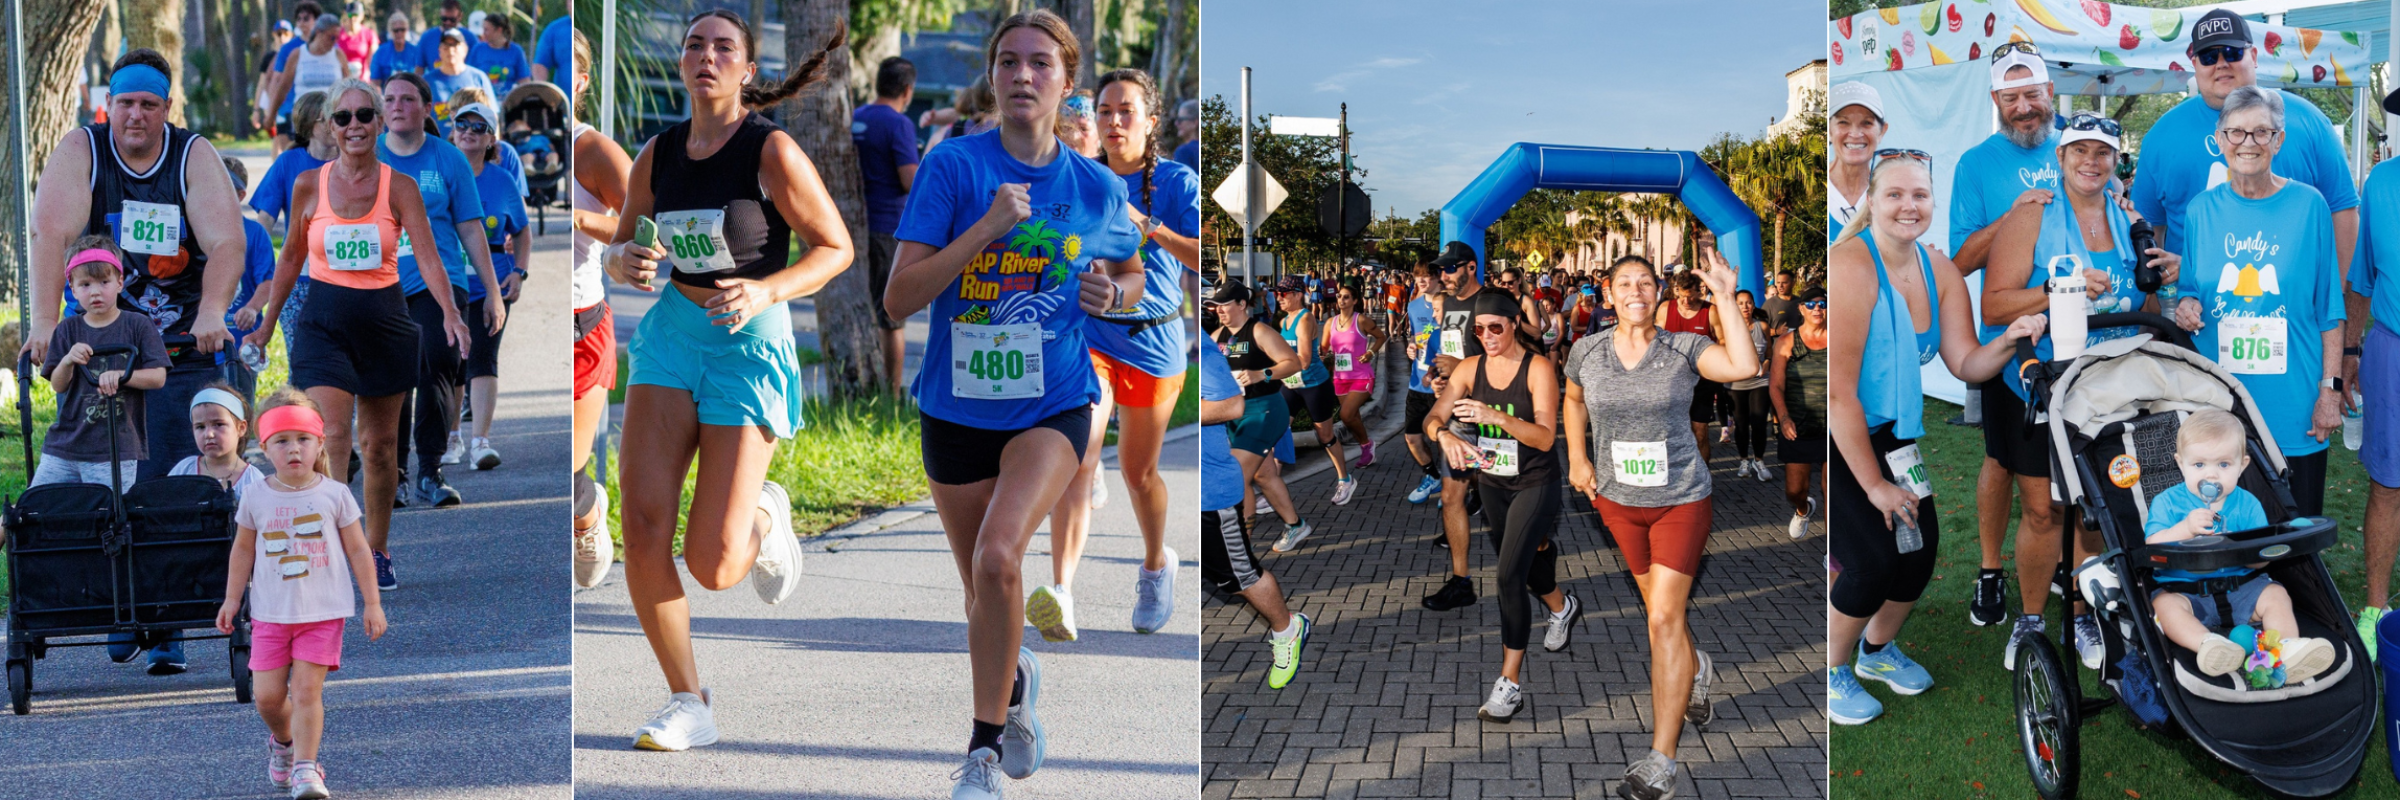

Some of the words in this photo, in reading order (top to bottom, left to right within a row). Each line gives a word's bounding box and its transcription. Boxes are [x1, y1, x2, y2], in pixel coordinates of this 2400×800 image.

[2201, 20, 2229, 36] PVPC
[133, 220, 165, 243] 821
[335, 240, 369, 260] 828
[672, 233, 715, 259] 860
[999, 251, 1050, 275] River
[959, 274, 1000, 301] Run
[2232, 337, 2270, 361] 876
[969, 350, 1024, 380] 480
[992, 384, 1002, 392] 5K
[1622, 459, 1656, 475] 1012
[275, 506, 298, 517] LET'S
[267, 519, 290, 530] HAVE
[293, 541, 328, 555] S'MORE
[311, 556, 329, 568] FUN
